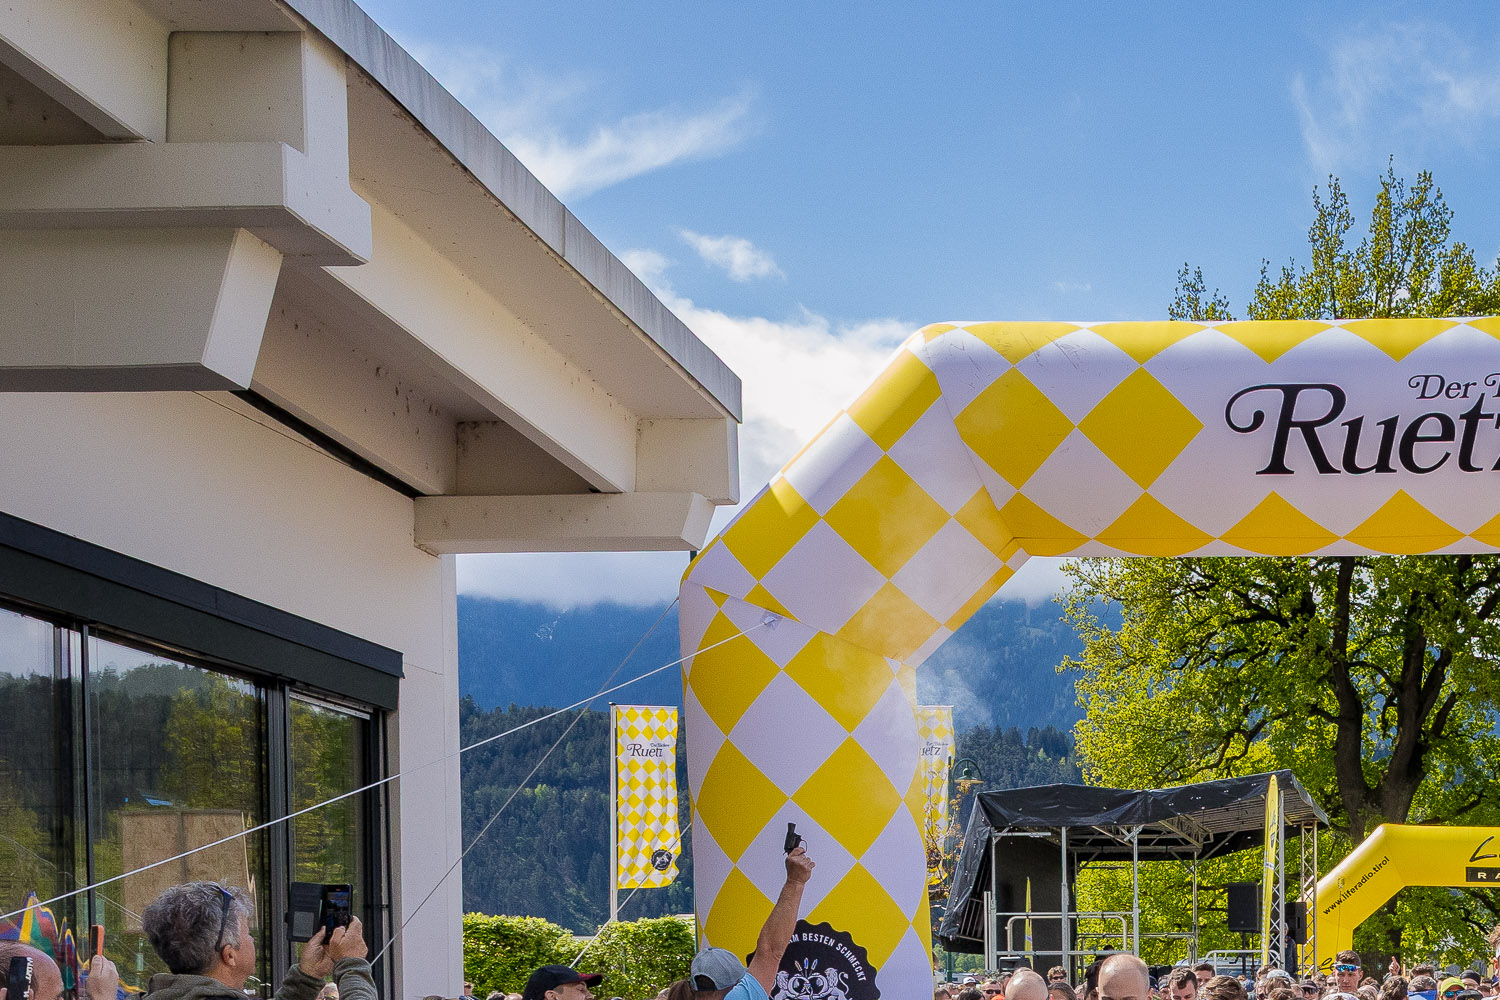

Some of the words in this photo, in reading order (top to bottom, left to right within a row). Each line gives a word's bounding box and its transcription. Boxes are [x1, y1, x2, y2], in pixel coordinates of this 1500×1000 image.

[1407, 373, 1477, 400] Der
[1322, 855, 1391, 916] www.liferadio.tirol
[802, 932, 836, 947] BESTEN
[835, 942, 868, 982] SCHMECKT
